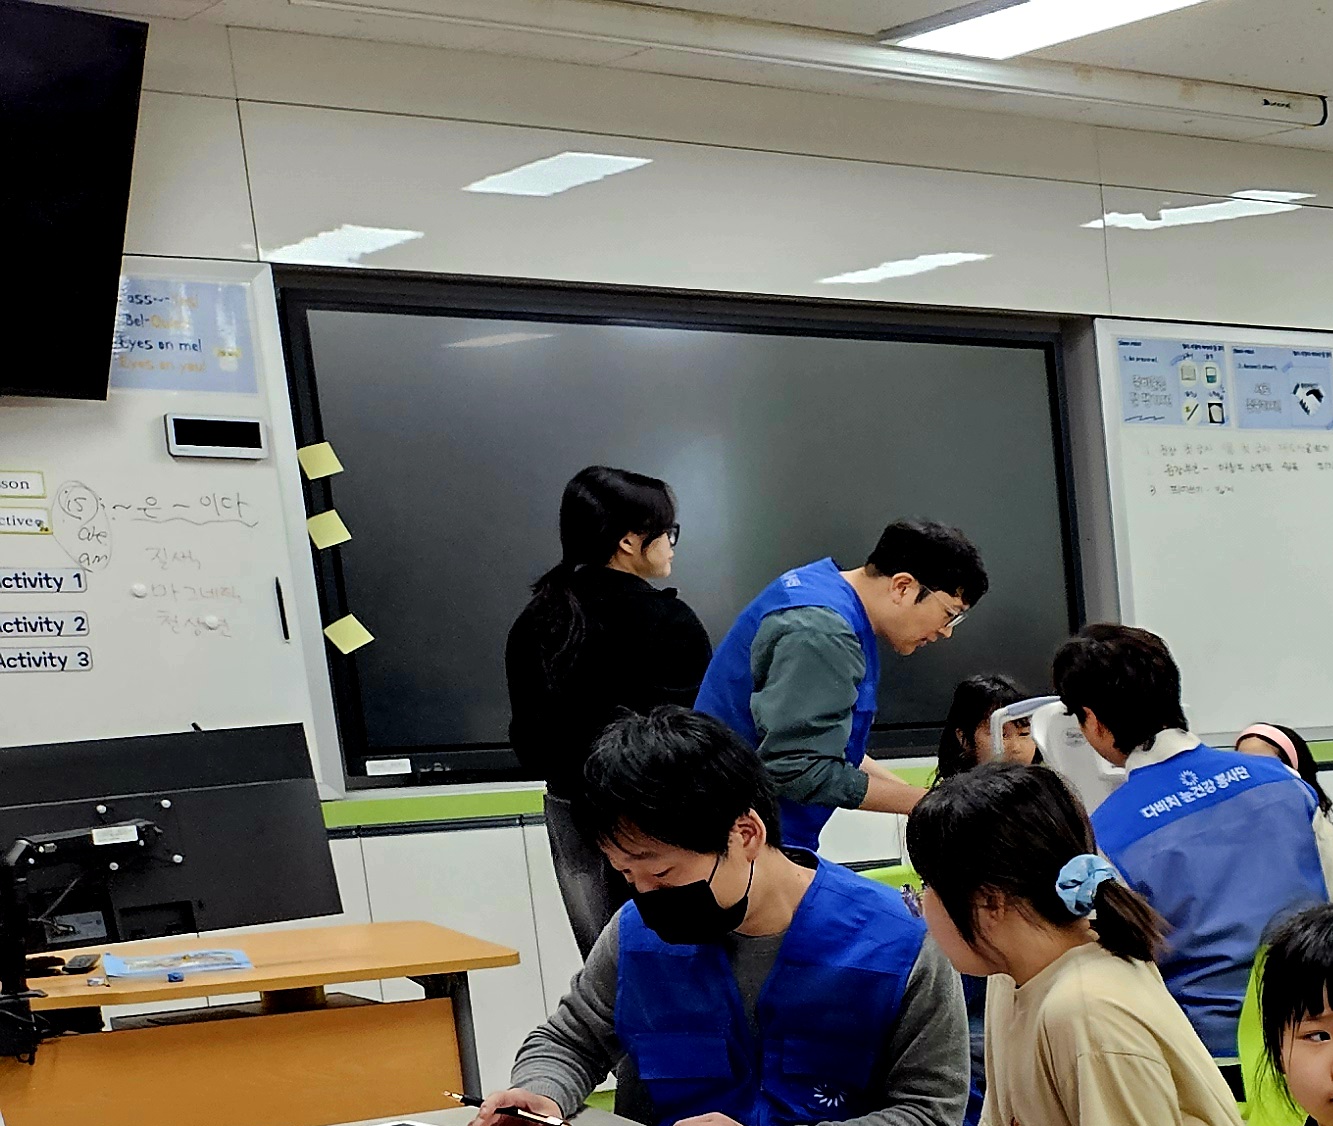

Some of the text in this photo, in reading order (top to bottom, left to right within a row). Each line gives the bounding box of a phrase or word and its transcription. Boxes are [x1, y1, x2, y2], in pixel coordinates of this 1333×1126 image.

[0, 572, 83, 592] ctivity 1
[0, 615, 87, 636] ctivity 2
[77, 652, 90, 668] 3
[1140, 765, 1251, 818] 다비치 눈건강 봉사단
